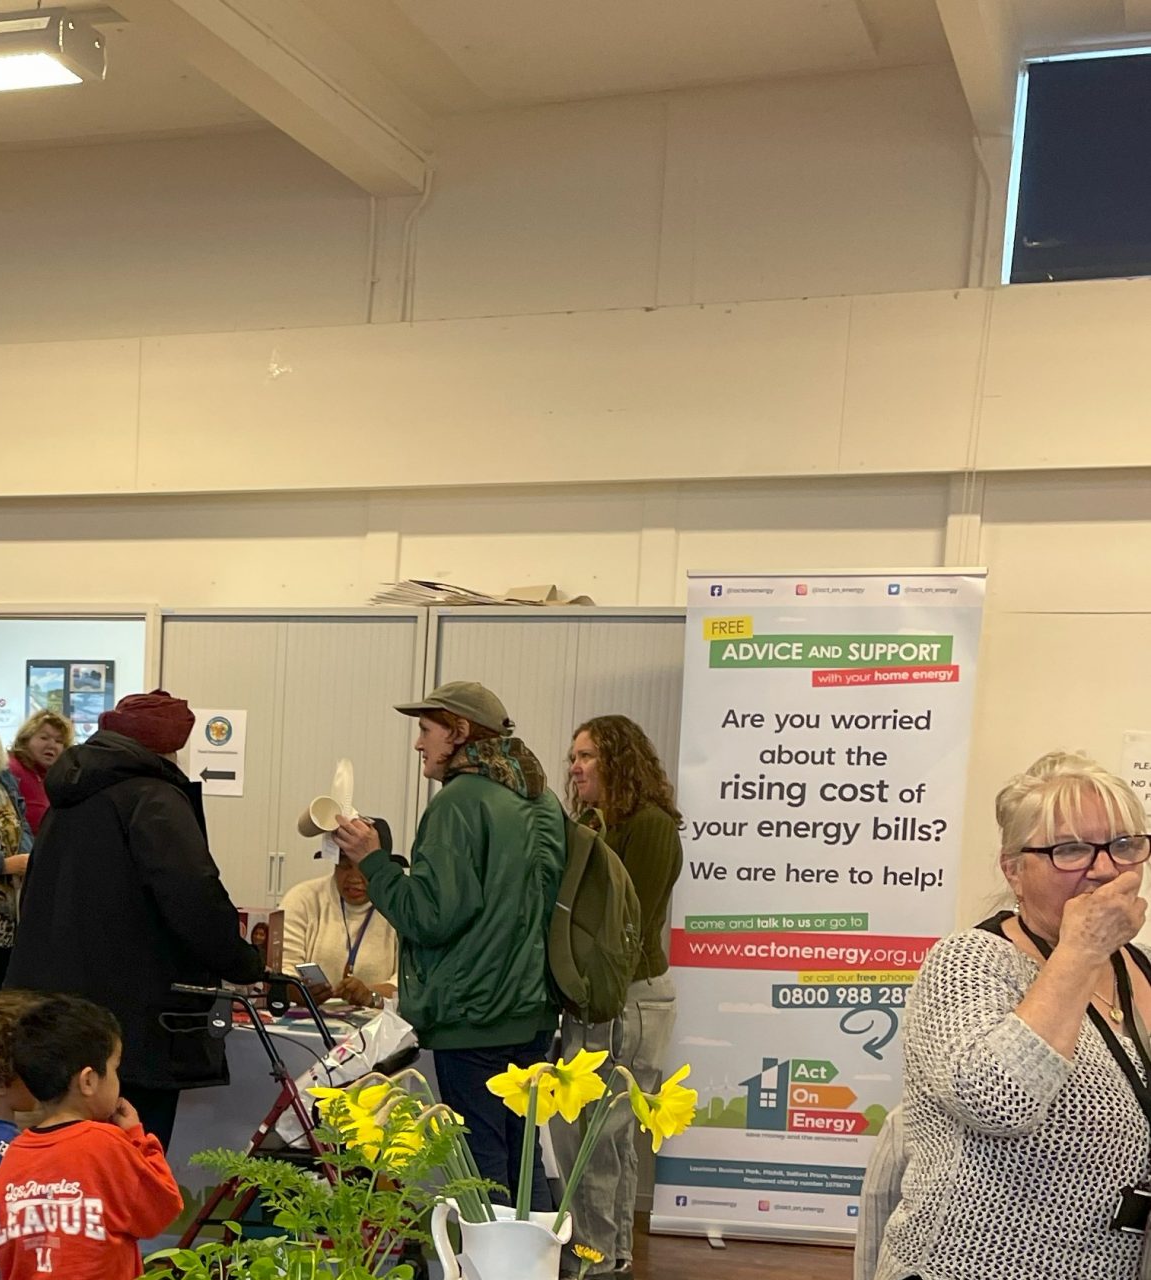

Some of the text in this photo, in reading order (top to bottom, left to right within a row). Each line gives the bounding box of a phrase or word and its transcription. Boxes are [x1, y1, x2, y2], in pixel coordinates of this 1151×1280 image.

[711, 620, 745, 635] FREE
[722, 643, 941, 661] ADVICE AND SUPPORT
[817, 669, 954, 685] with your home energy
[722, 709, 932, 733] Are you worried
[759, 745, 887, 766] about the
[720, 774, 926, 807] rising cost of
[692, 817, 948, 845] your energy bills?
[690, 862, 944, 891] We are here to help!
[690, 917, 863, 931] come and talk to us or go to
[816, 973, 834, 983] call
[856, 973, 877, 983] free
[779, 987, 872, 1006] 0800 988
[794, 1064, 828, 1080] Act
[793, 1089, 820, 1104] On
[793, 1113, 856, 1132] Energy
